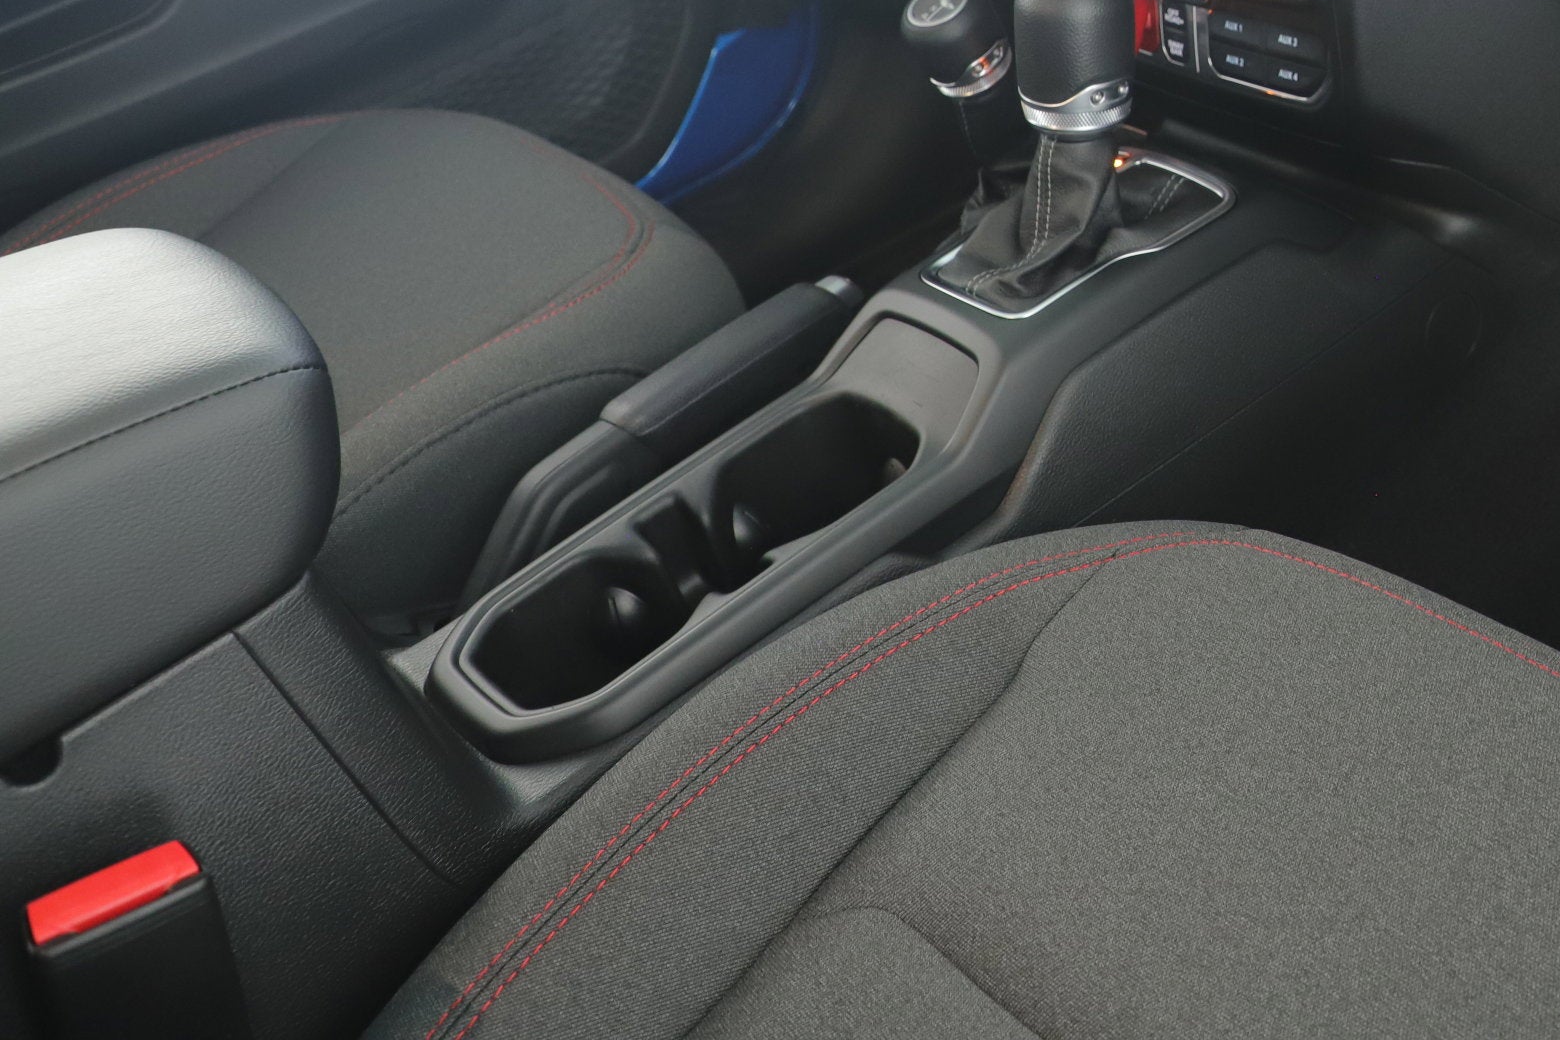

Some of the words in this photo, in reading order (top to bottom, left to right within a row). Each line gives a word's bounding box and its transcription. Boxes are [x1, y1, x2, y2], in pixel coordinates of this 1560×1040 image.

[1224, 20, 1238, 31] AUX
[1278, 34, 1292, 46] AUX
[1226, 54, 1239, 66] AUX
[1278, 69, 1292, 80] AUX
